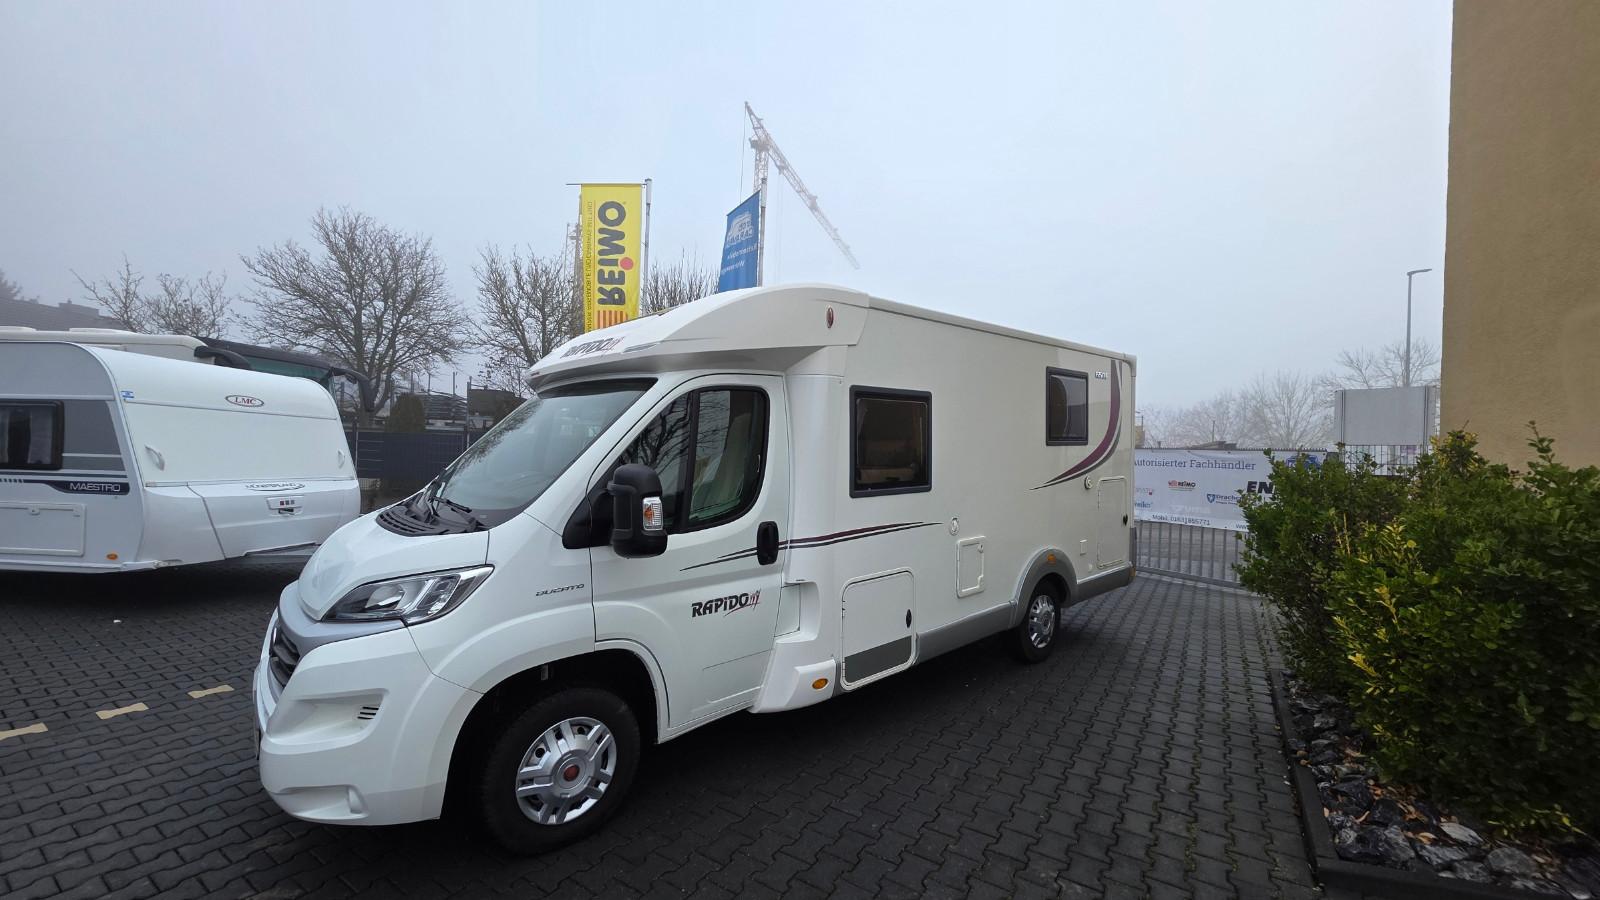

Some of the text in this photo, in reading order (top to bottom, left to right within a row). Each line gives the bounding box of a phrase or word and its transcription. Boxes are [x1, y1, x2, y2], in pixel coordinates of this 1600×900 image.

[234, 396, 256, 405] LMC
[70, 483, 120, 492] MAESTRO
[535, 583, 585, 596] DUCATO
[692, 593, 749, 617] RAPIDO
